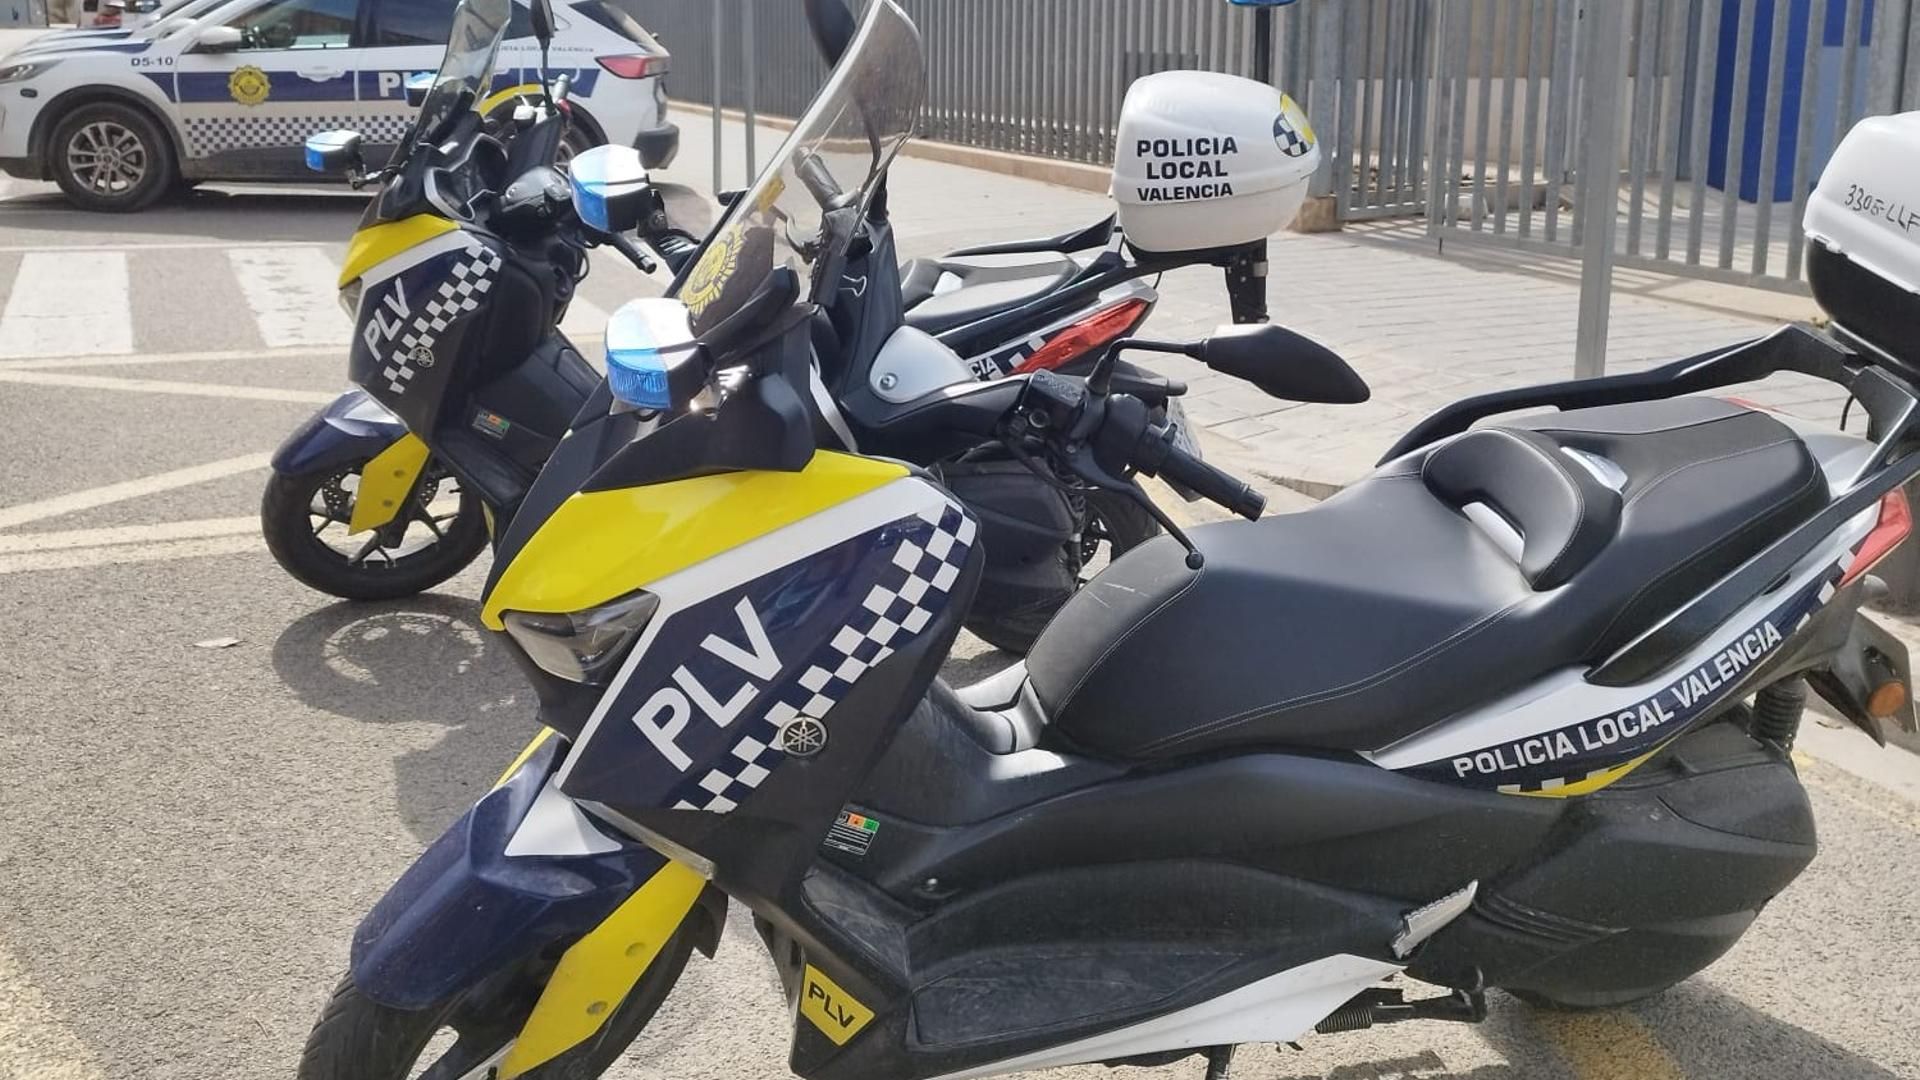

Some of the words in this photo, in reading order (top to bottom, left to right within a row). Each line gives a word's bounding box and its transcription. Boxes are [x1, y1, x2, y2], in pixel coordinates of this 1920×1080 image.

[1136, 136, 1238, 157] POLICIA
[1146, 160, 1228, 179] LOCAL
[1137, 183, 1233, 201] VALENCIA
[363, 276, 411, 362] PLV
[969, 357, 998, 377] CIA
[632, 595, 783, 773] PLV
[1452, 732, 1578, 777] POLICIA
[1578, 699, 1675, 751] LOCAL
[1670, 620, 1783, 709] VALENCIA
[808, 981, 856, 1029] PLV
